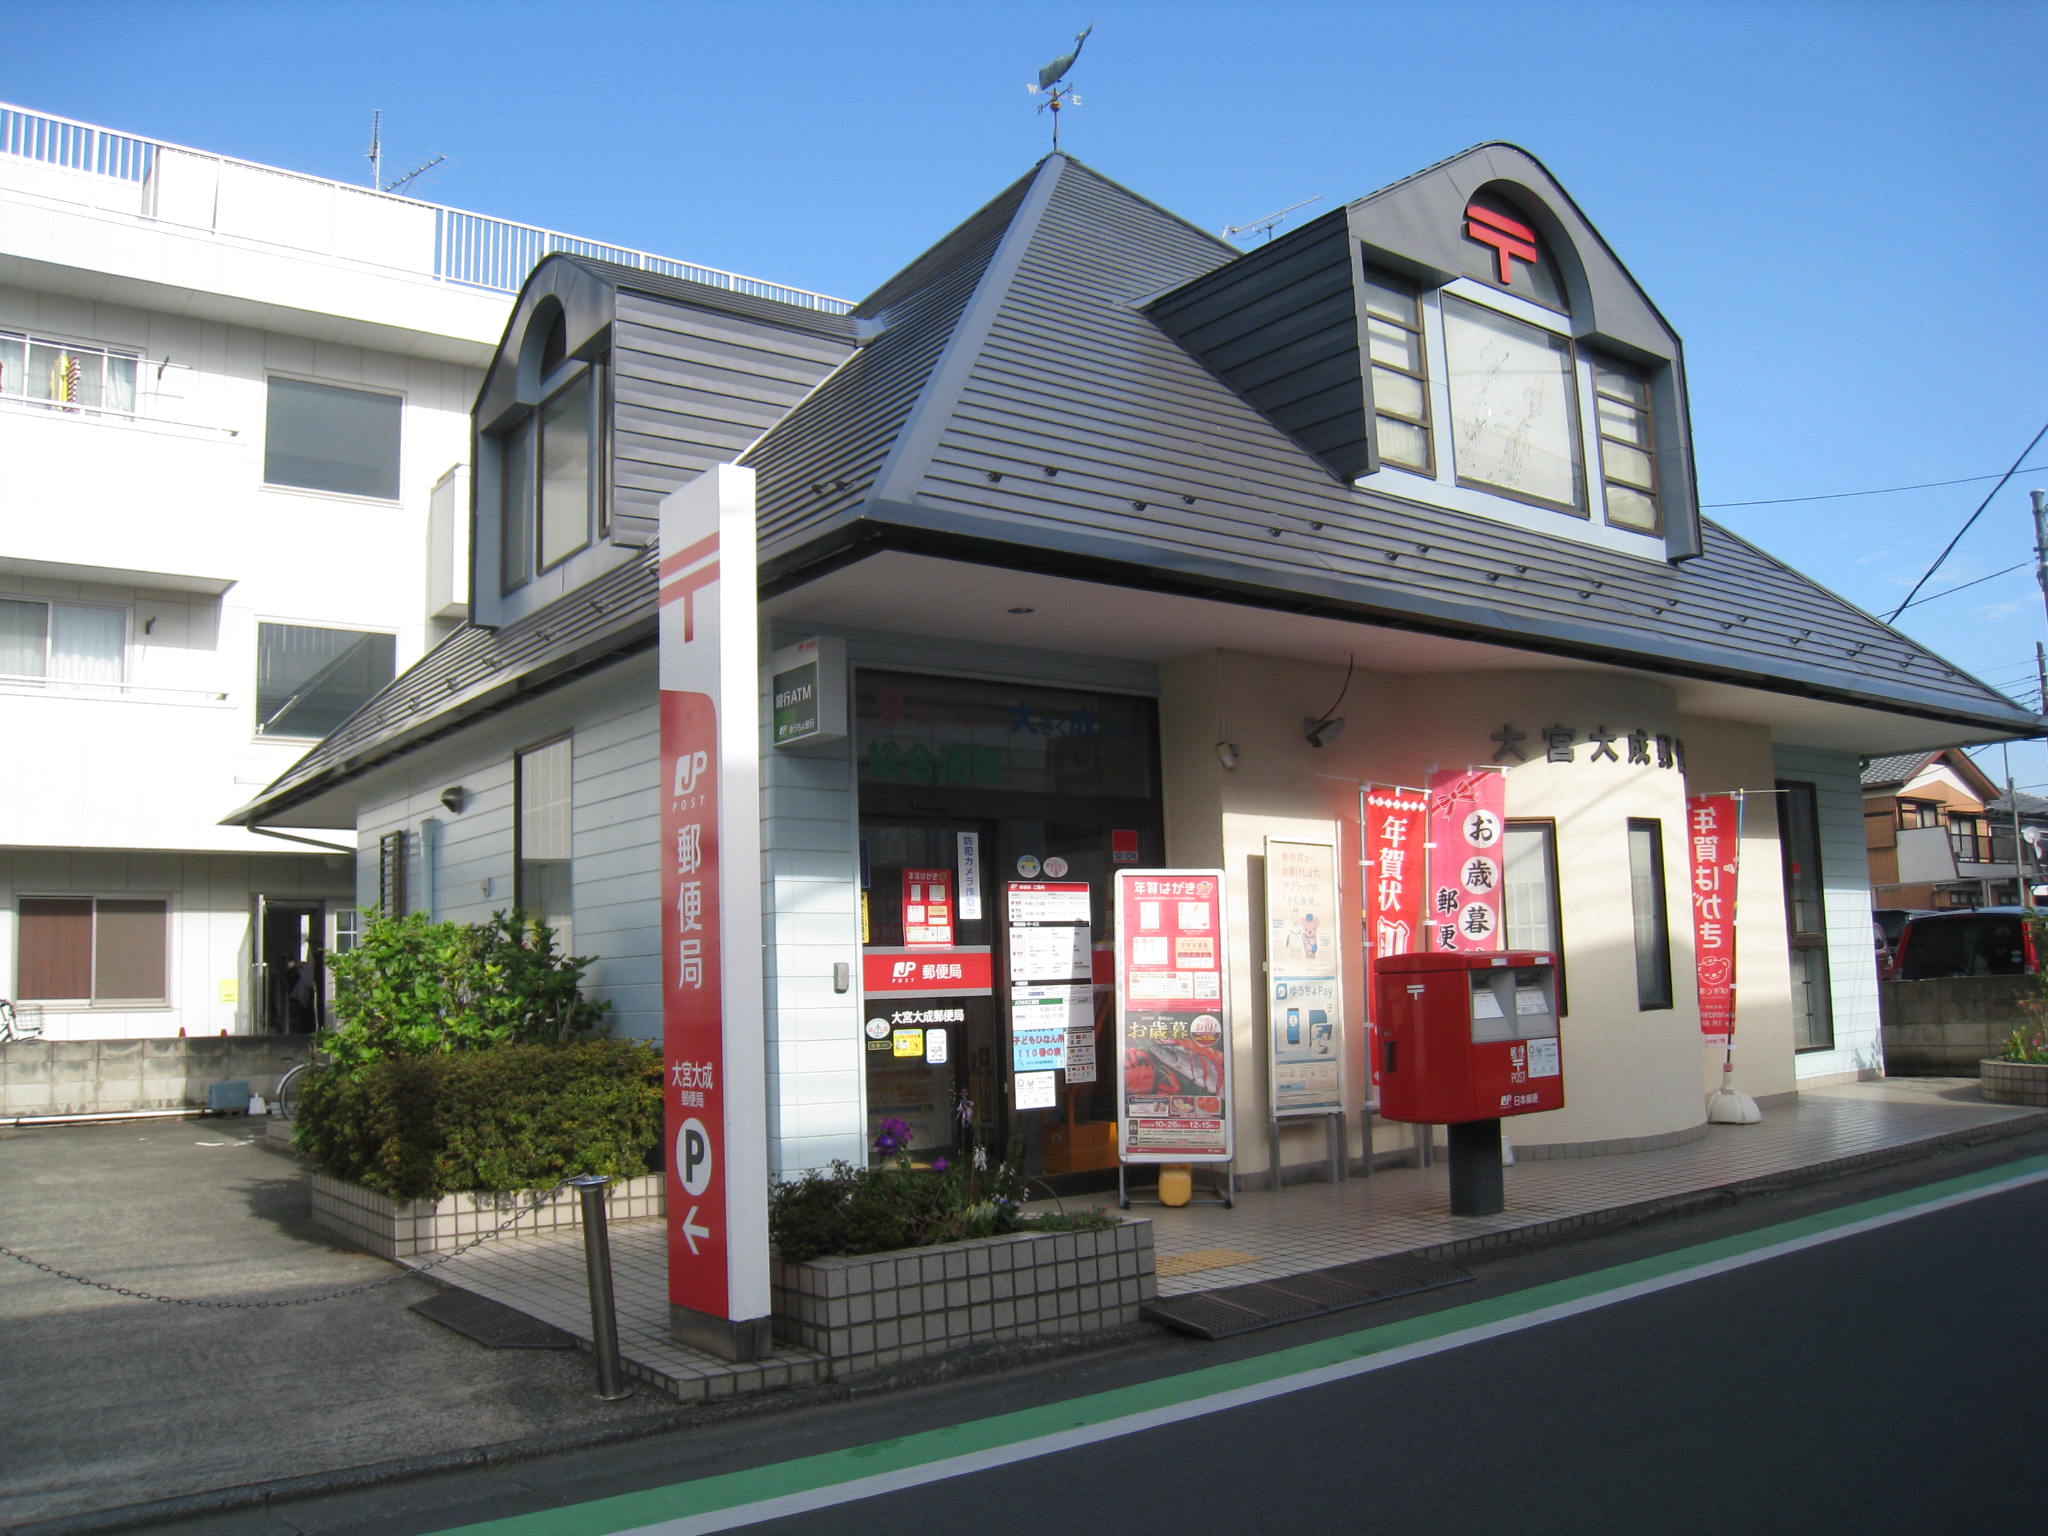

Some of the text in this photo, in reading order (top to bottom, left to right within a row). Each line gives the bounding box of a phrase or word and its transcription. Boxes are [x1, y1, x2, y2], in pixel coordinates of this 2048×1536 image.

[1072, 94, 1082, 106] E
[775, 684, 812, 709] 銀行ATM
[672, 795, 706, 813] POST
[1134, 881, 1196, 895] 年賀はがき
[677, 823, 703, 990] 郵便局
[922, 963, 963, 979] 郵便局
[1289, 985, 1334, 999] ゆうちょPay
[891, 1008, 965, 1025] 大宮大成郵便局
[1128, 1021, 1189, 1040] お歳暮
[1510, 1045, 1526, 1060] 郵便
[671, 1060, 714, 1090] 大宮大成
[1511, 1070, 1527, 1084] POST
[681, 1090, 705, 1109] 郵便局
[1514, 1092, 1539, 1106] 日本郵便
[685, 1128, 705, 1183] P
